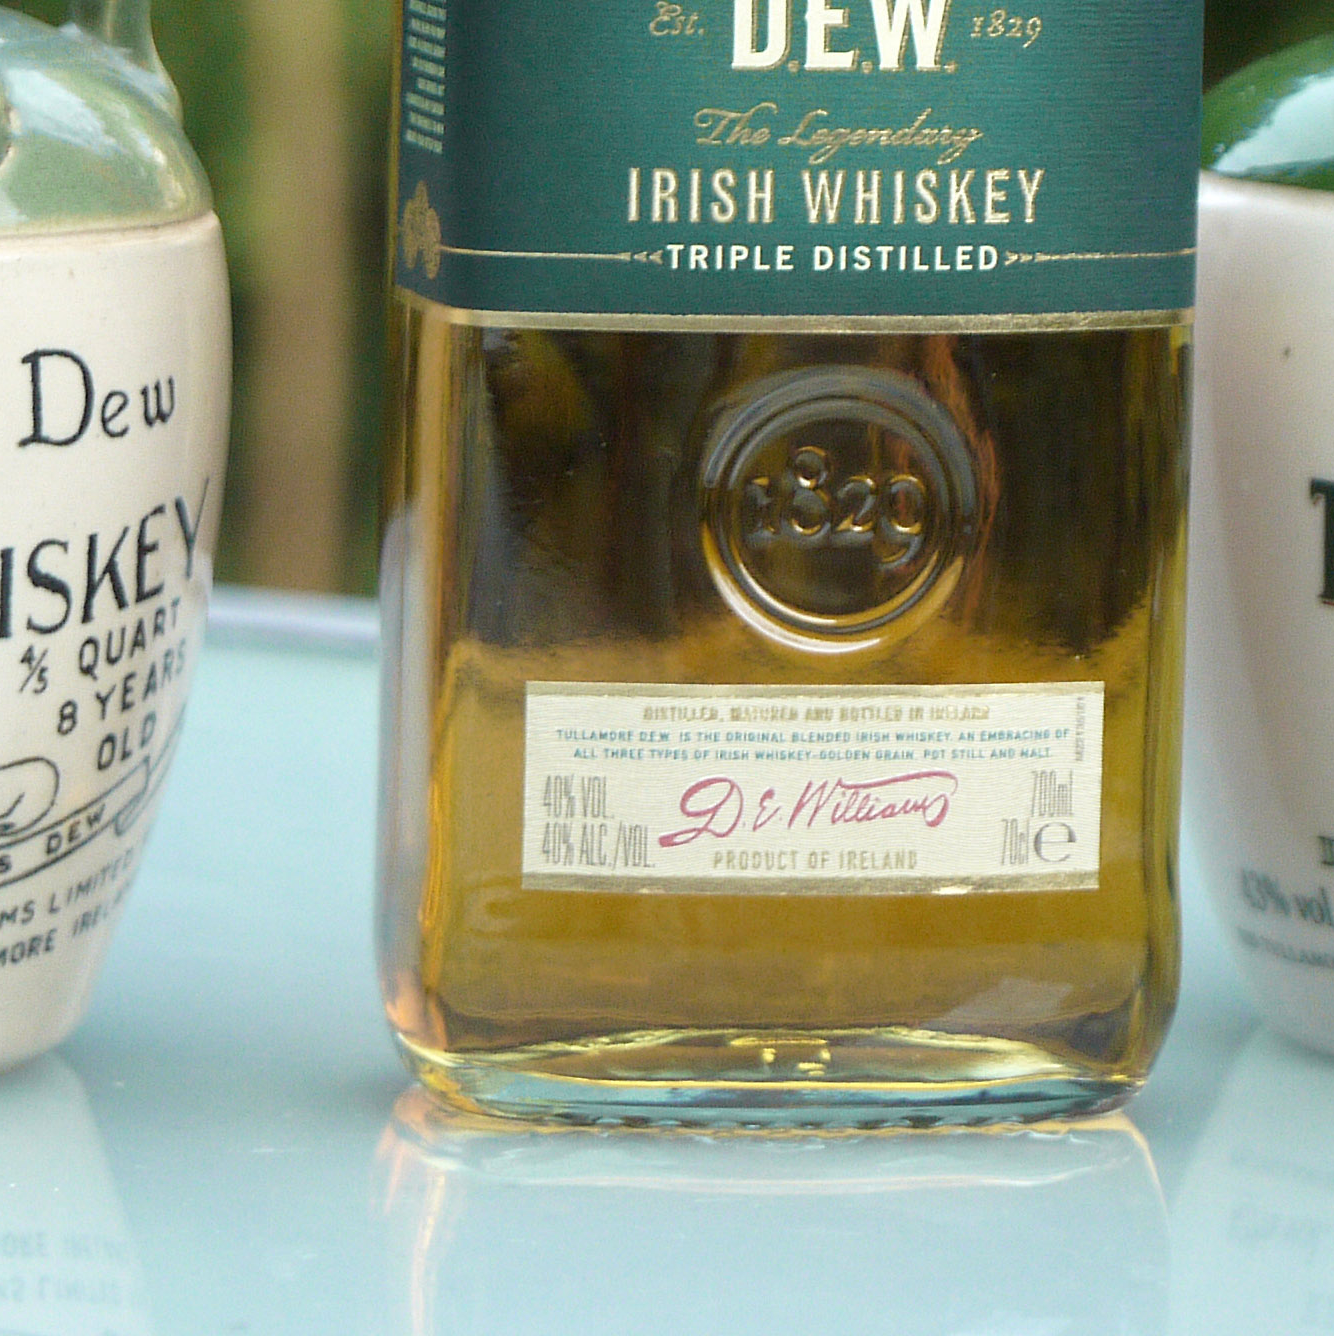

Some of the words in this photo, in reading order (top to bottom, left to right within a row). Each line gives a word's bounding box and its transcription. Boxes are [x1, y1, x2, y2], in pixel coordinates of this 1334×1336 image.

[649, 1, 705, 37] Est.
[970, 9, 1043, 48] 1829
[693, 101, 778, 145] The
[777, 107, 984, 165] Legendary
[627, 167, 775, 224] IRISH
[801, 167, 1046, 224] WHISKEY
[666, 244, 795, 271] TRIPLE
[813, 244, 999, 272] DISTILLED
[17, 347, 178, 448] Dew
[78, 596, 181, 681] QUART
[57, 699, 78, 736] 8
[95, 638, 187, 720] YEARS
[97, 710, 157, 771] OLD
[556, 729, 634, 742] TULLAMORE
[679, 730, 692, 742] IS
[697, 730, 721, 742] THE
[726, 730, 786, 743] ORIGINAL
[791, 730, 851, 743] BLENDED
[856, 730, 890, 743] IRISH
[958, 730, 975, 742] AN
[980, 729, 1050, 742] EMBRACING
[1055, 727, 1070, 739] OF
[574, 748, 598, 760] ALL
[604, 748, 644, 760] THREE
[649, 748, 689, 761] TYPES
[694, 748, 710, 760] OF
[716, 748, 749, 761] IRISH
[923, 747, 944, 760] POT
[951, 747, 985, 760] STILL
[990, 746, 1015, 759] AND
[543, 774, 576, 819] 40%
[580, 775, 615, 819] VOL.
[787, 770, 959, 829] Williams
[1030, 769, 1076, 818] 700ml
[45, 804, 106, 855] DEW
[541, 821, 576, 866] 40%
[1001, 818, 1029, 866] 70cl
[713, 849, 798, 870] PRODUCT
[807, 849, 830, 870] OF
[838, 849, 918, 870] IRELAND
